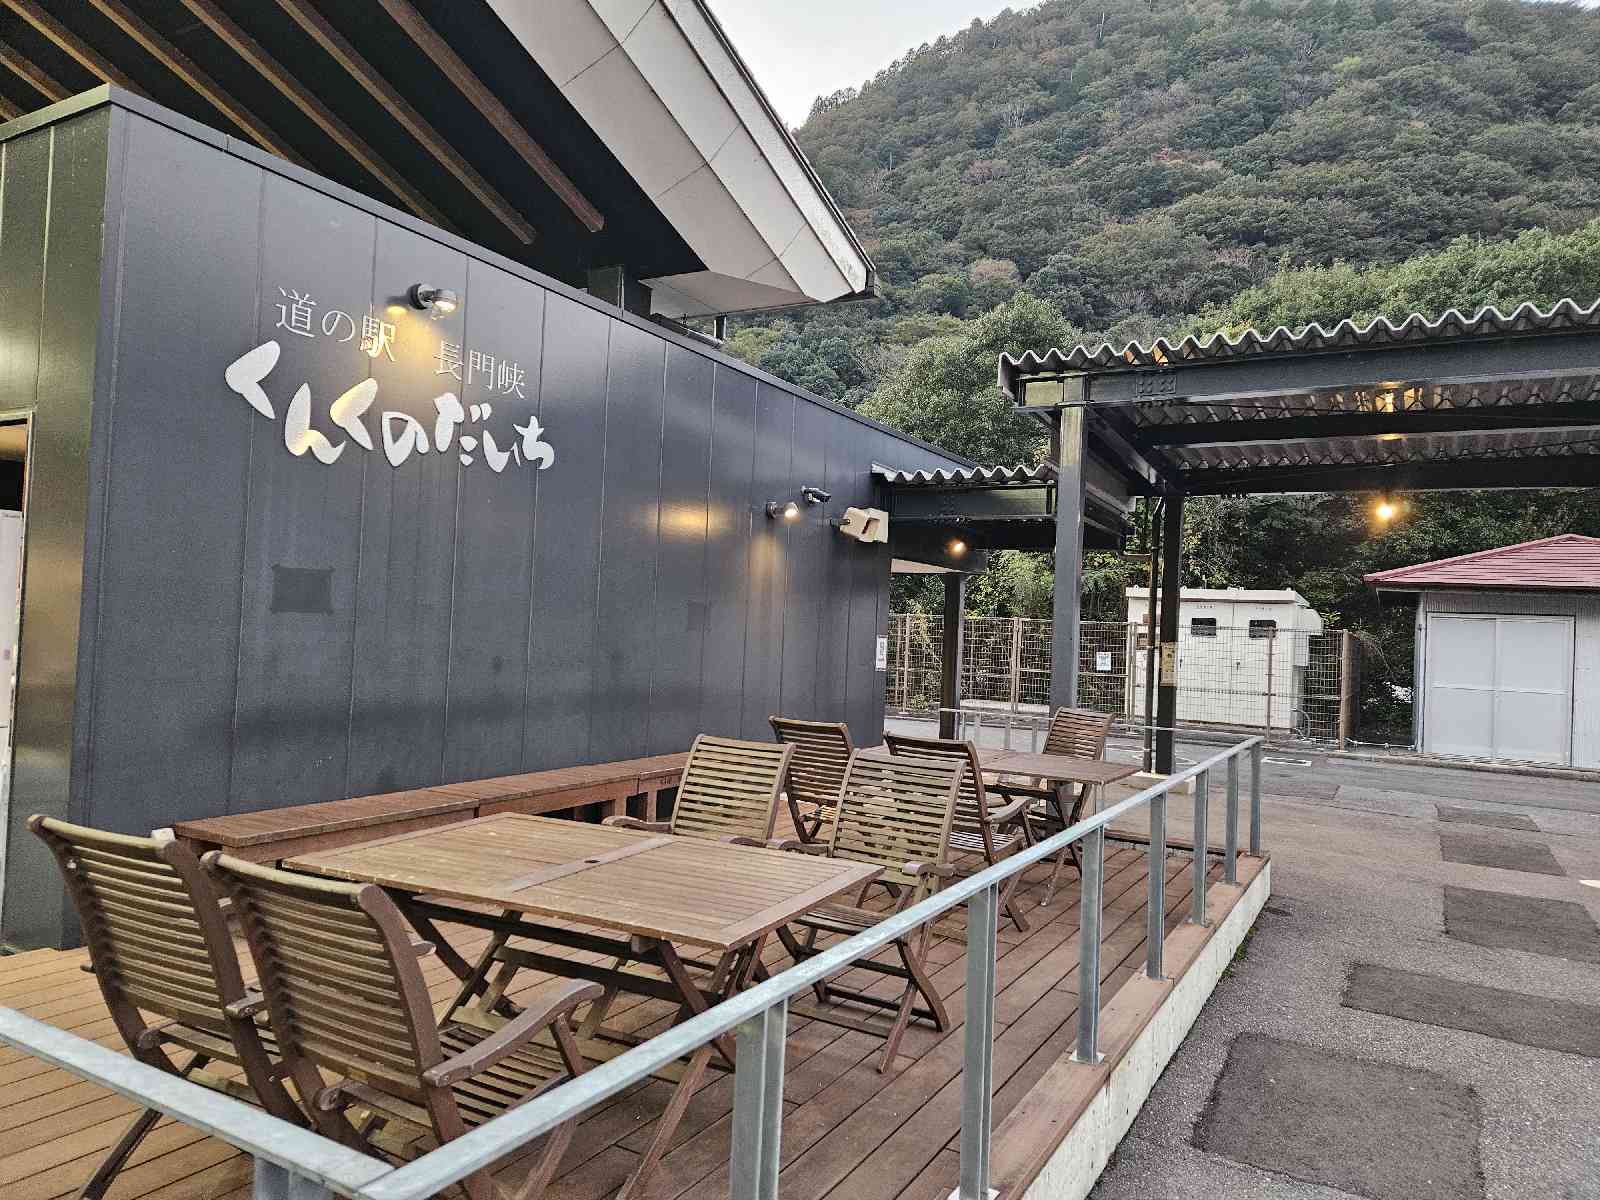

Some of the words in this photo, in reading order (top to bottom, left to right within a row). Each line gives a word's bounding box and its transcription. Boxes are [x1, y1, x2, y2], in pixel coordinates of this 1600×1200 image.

[275, 286, 397, 362] 道の駅
[433, 340, 526, 399] 長門峡
[224, 339, 555, 473] くんくのだいち
